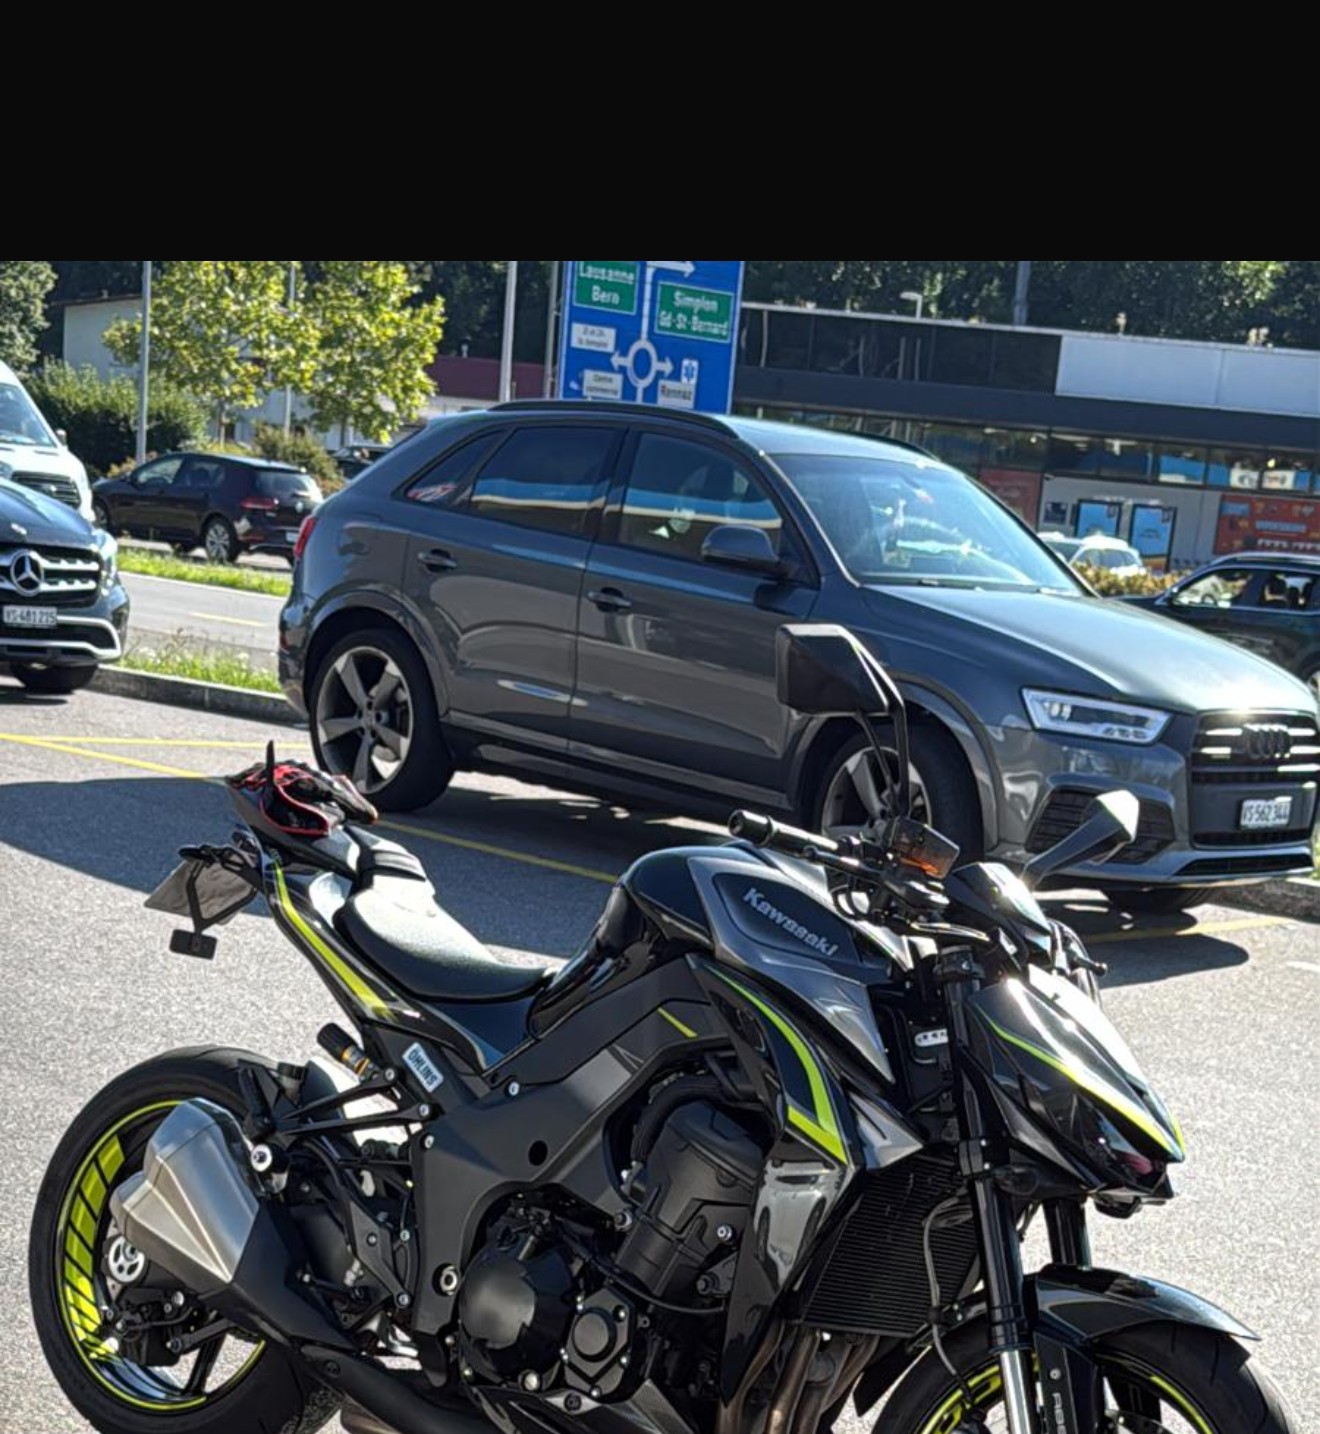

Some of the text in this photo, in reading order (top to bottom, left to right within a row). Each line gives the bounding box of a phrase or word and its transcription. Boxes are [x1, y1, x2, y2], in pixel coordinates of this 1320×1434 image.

[579, 261, 634, 285] Lausanne
[592, 285, 620, 305] Bern
[673, 290, 718, 315] Simplon
[743, 888, 839, 956] Kawasaki
